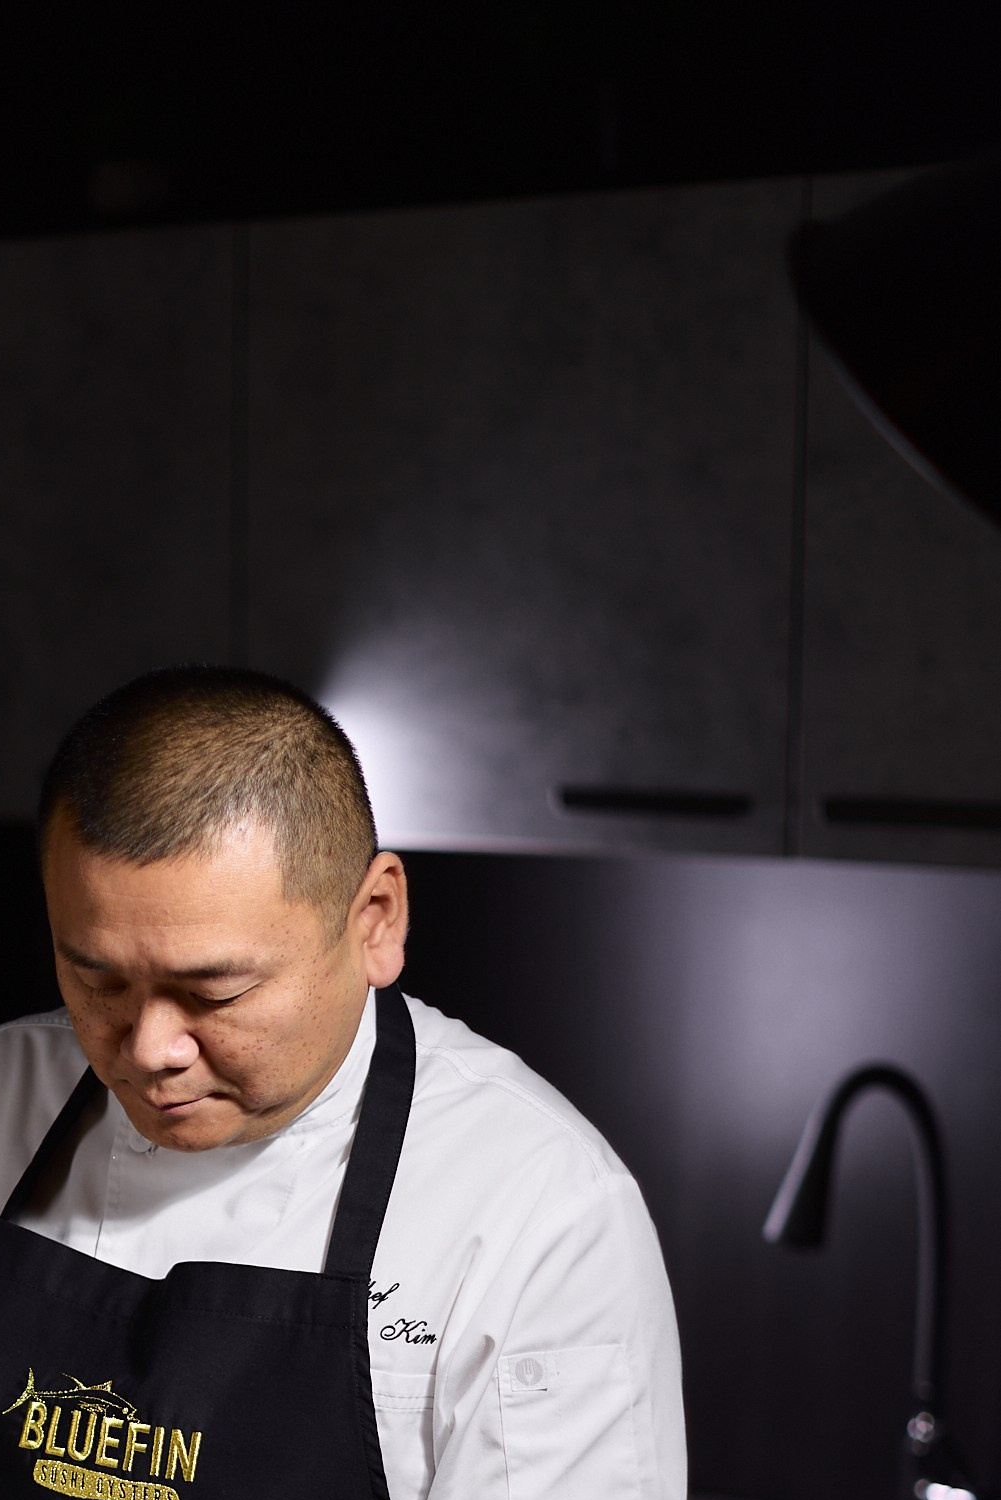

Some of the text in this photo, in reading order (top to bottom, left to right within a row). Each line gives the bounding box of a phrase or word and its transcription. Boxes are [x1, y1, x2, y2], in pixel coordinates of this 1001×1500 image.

[380, 1318, 437, 1345] Kim
[18, 1401, 203, 1483] BLUEFIN
[40, 1464, 86, 1491] SUSHI
